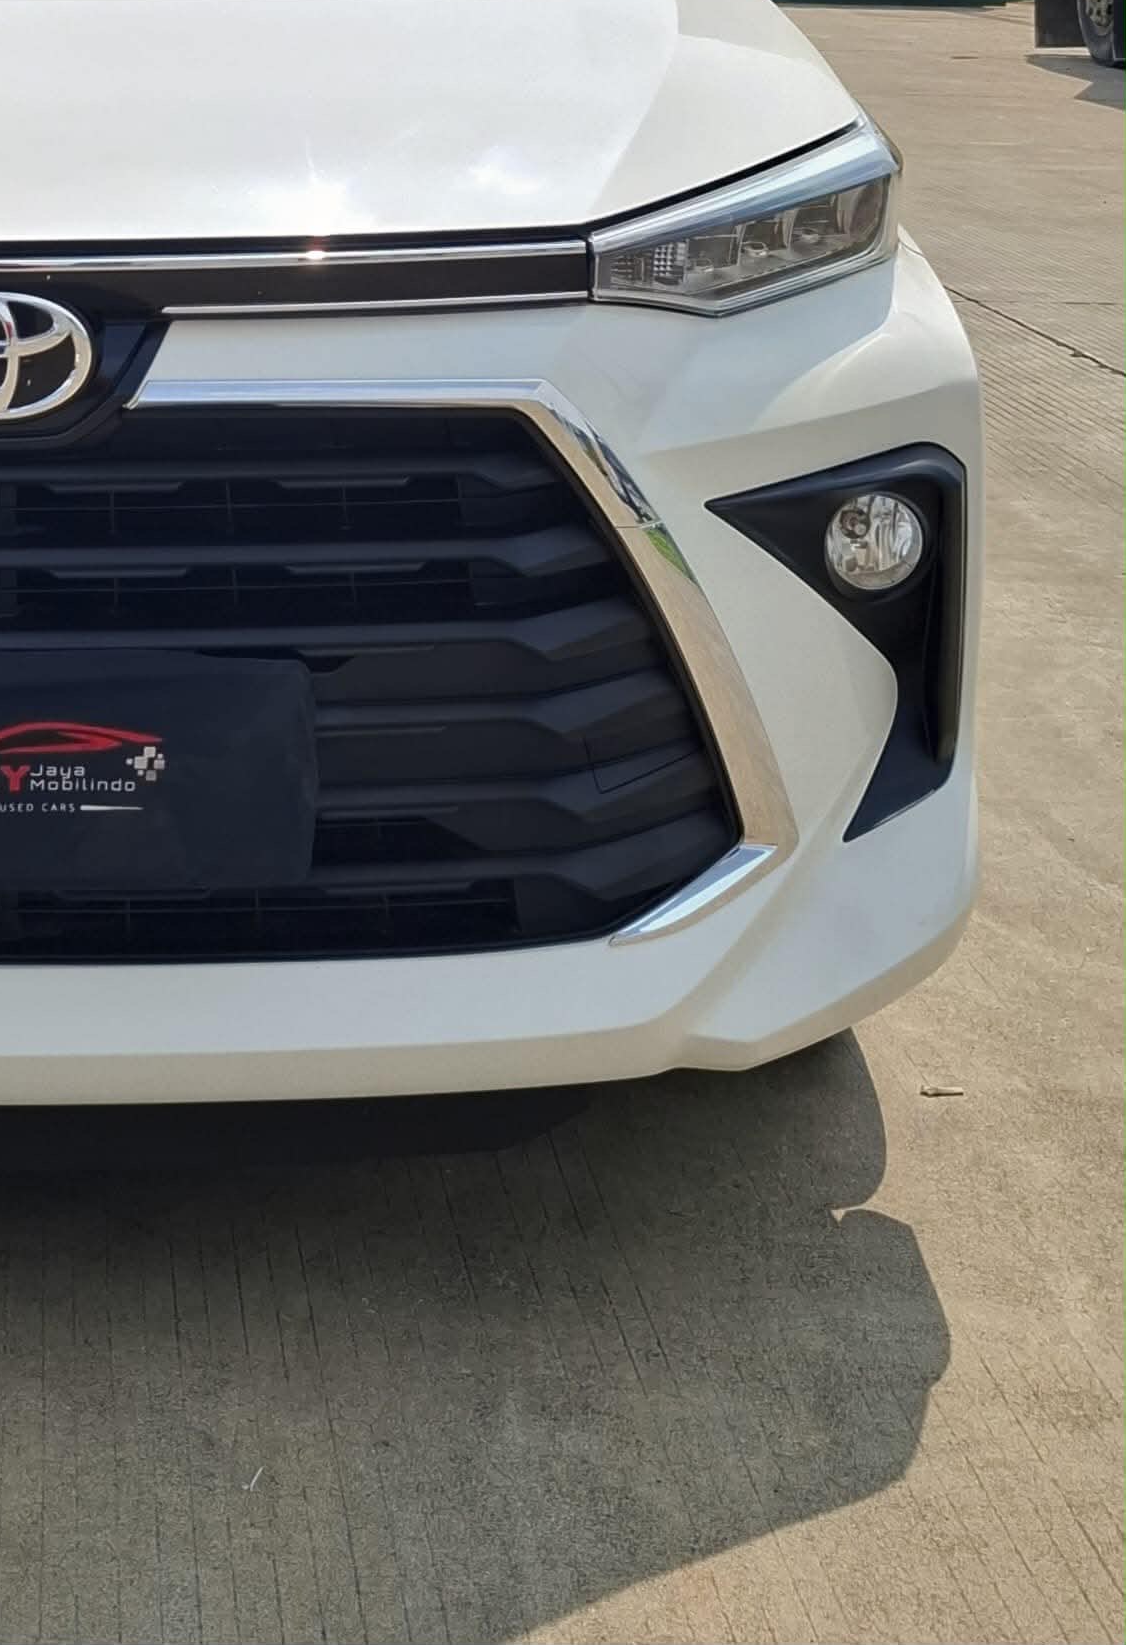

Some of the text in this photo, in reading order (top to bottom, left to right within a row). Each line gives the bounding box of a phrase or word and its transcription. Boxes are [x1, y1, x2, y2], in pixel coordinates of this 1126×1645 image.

[30, 764, 85, 779] Jaya
[30, 778, 136, 792] Mobilindo
[0, 802, 34, 813] USED
[41, 802, 76, 813] CARS
